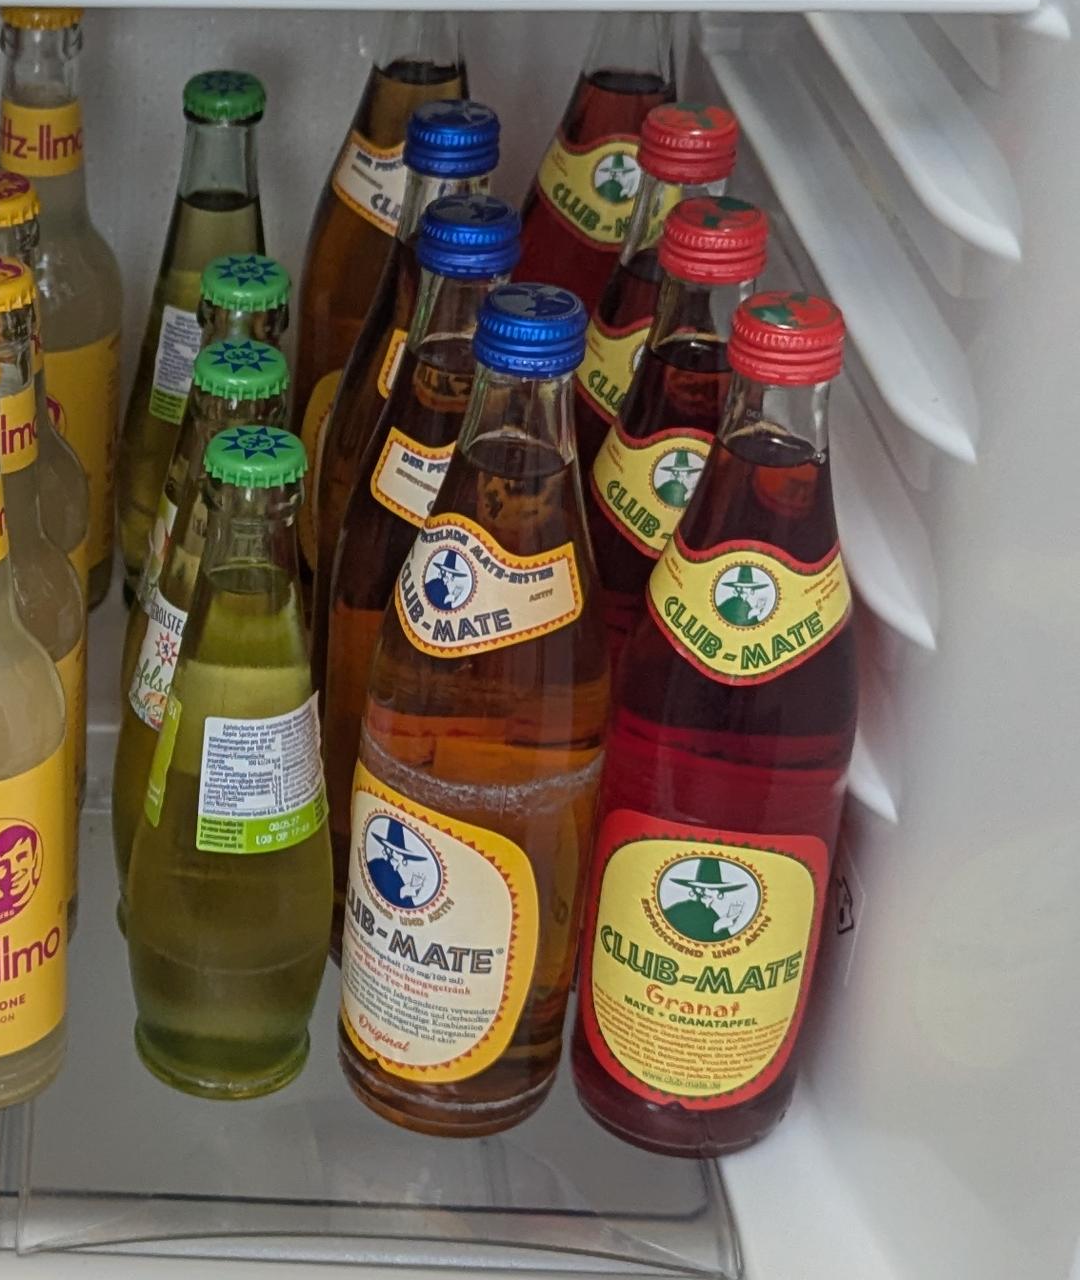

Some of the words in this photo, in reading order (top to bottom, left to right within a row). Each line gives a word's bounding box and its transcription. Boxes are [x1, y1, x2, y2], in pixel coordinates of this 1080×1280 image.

[606, 480, 674, 540] CLUB-
[664, 595, 825, 670] CLUB-MATE
[600, 924, 803, 995] CLUB-MATE
[712, 946, 741, 959] UND
[624, 995, 654, 1017] MATE
[669, 1014, 758, 1029] GRANATAPFEL
[645, 983, 740, 1018] Granat
[358, 1013, 411, 1052] Original
